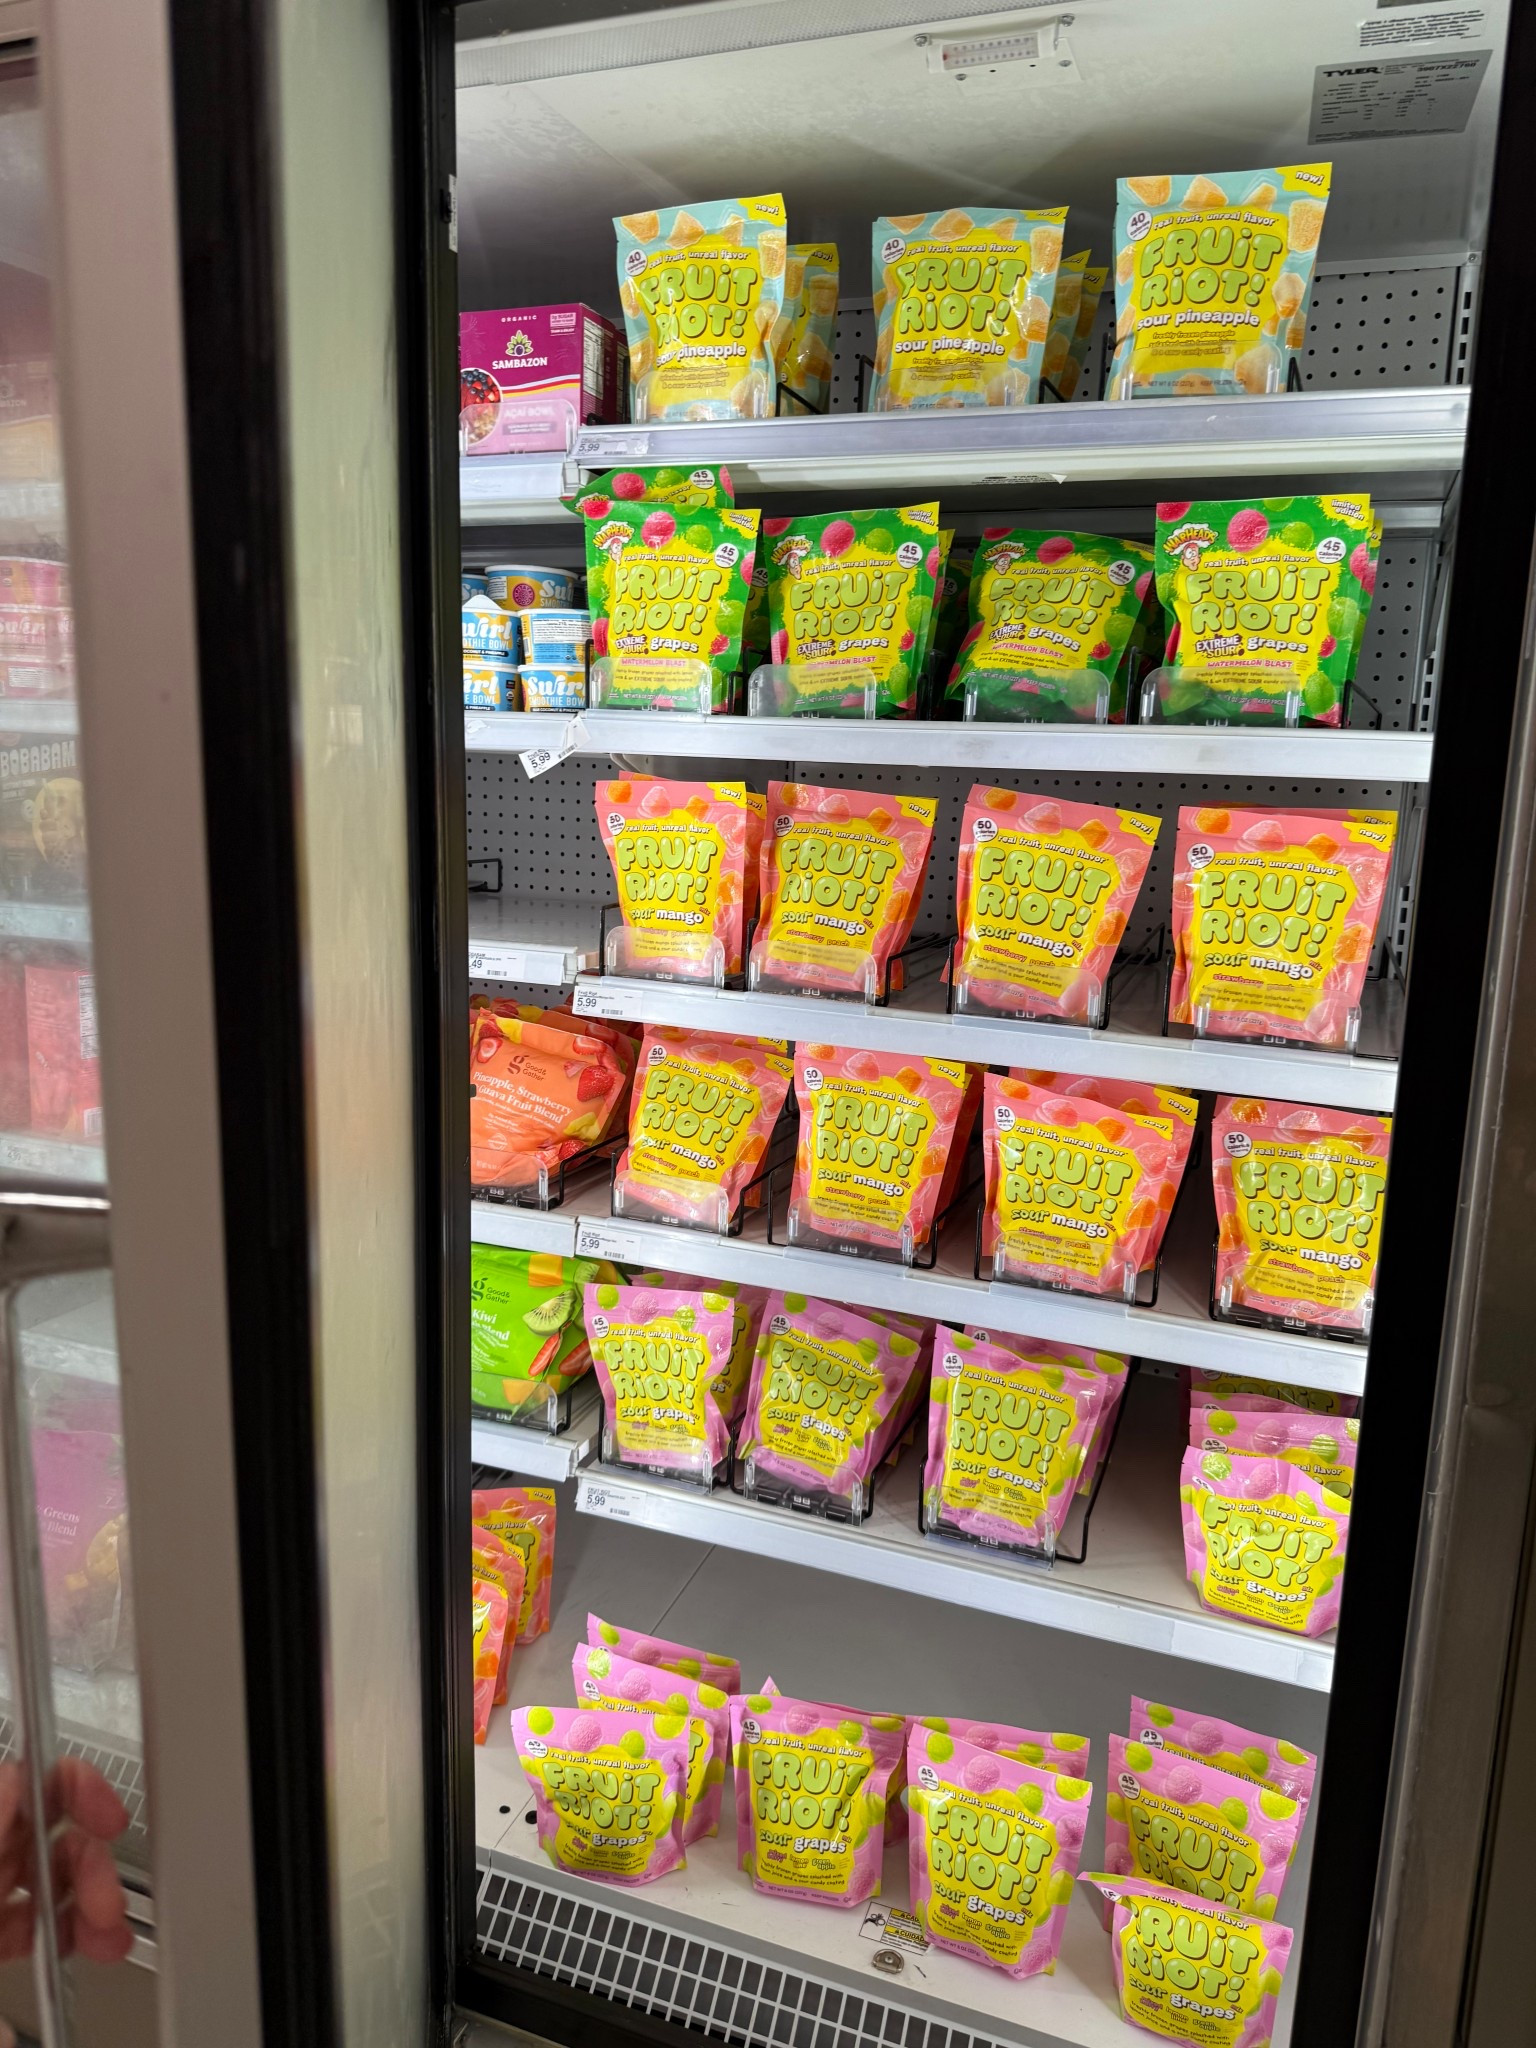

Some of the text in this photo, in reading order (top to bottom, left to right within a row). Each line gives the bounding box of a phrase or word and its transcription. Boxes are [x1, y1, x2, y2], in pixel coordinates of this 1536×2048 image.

[1322, 67, 1382, 77] TYLER
[1295, 170, 1324, 186] new!
[1130, 212, 1146, 228] 40
[501, 315, 537, 323] ORGANIC
[1136, 309, 1260, 331] sour pineapple
[895, 336, 1005, 356] sour pineapple
[492, 357, 549, 370] SAMBAZON
[578, 443, 600, 452] 5.99
[1331, 499, 1361, 511] limited
[1335, 507, 1364, 520] edition
[1163, 528, 1216, 551] WARHEADS
[771, 537, 812, 563] WARHEADS
[1204, 554, 1311, 568] real fruit, unreal flavor
[463, 616, 512, 640] wirl
[650, 636, 699, 653] grapes
[838, 637, 889, 652] grapes
[1027, 626, 1081, 652] grapes
[1195, 635, 1240, 652] EXTREME
[1247, 637, 1308, 653] grapes
[797, 641, 833, 654] EXTREME
[1039, 646, 1064, 658] BLAST
[1206, 647, 1237, 658] SOUR
[853, 656, 876, 664] BLAST
[1207, 660, 1293, 668] WATERMELON BLAST
[473, 695, 496, 704] BOWL
[529, 697, 585, 706] SMOOTHIE BOW
[531, 752, 551, 768] 5.99
[720, 786, 742, 799] new!
[909, 803, 931, 817] new!
[609, 814, 621, 824] 50
[777, 817, 789, 826] 50
[978, 821, 992, 829] 50
[1130, 817, 1153, 835] new!
[1359, 828, 1386, 842] new!
[997, 835, 1106, 864] real fruit, unreal flavor
[1192, 847, 1208, 856] 50
[1215, 857, 1339, 875] real fruit, unreal flavor
[656, 908, 704, 926] mango
[781, 911, 865, 936] sour mango
[978, 925, 1074, 957] sour mango
[469, 959, 482, 969] .49
[1204, 952, 1313, 979] sour mango
[577, 997, 597, 1008] 5.99
[774, 1058, 793, 1072] new!
[937, 1063, 961, 1079] new!
[806, 1069, 818, 1080] 50
[473, 1071, 515, 1092] Pineapple,
[517, 1086, 573, 1117] Strawberry
[479, 1084, 506, 1101] Guava
[506, 1094, 532, 1111] Fruit
[534, 1104, 564, 1124] Blend
[1168, 1097, 1193, 1116] new!
[997, 1108, 1010, 1118] 50
[1142, 1117, 1169, 1132] new!
[1015, 1124, 1126, 1157] real fruit, unreal flavor
[1229, 1134, 1245, 1144] 50
[817, 1167, 905, 1197] sour mango
[1011, 1209, 1109, 1238] sour mango
[581, 1237, 600, 1249] 5.99
[1259, 1239, 1363, 1270] sour mango
[472, 1308, 497, 1325] Kiwi
[964, 1370, 1066, 1403] real fruit, unreal flavor
[767, 1407, 846, 1442] sour grapes
[951, 1458, 1042, 1492] sour grapes
[1313, 1465, 1343, 1476] flavor
[587, 1494, 606, 1506] 5.99
[43, 1505, 80, 1524] Greens
[1238, 1503, 1328, 1529] fruit, unreal flavor
[1140, 1796, 1249, 1847] real fruit, unreal flavor
[794, 1836, 846, 1854] grapes
[968, 1894, 1025, 1925] grapes
[962, 1912, 982, 1926] lemon
[1217, 1911, 1249, 1930] flavor
[900, 1930, 925, 1942] CUIDAD
[1170, 1992, 1236, 2021] grapes
